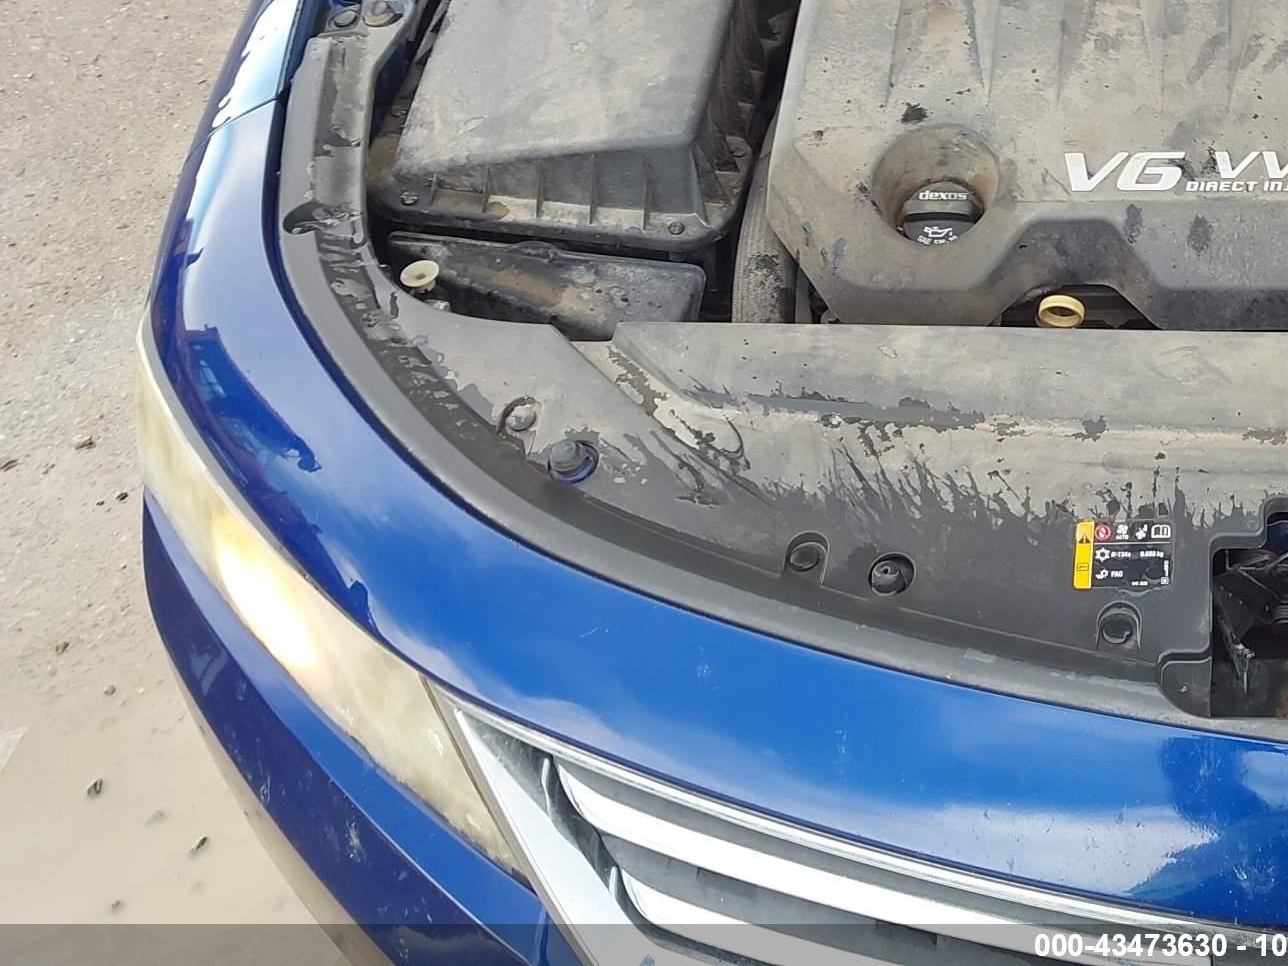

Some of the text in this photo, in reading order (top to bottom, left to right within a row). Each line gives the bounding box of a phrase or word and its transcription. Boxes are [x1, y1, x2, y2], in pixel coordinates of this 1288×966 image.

[1064, 151, 1186, 192] V6
[1185, 181, 1260, 192] DIRECT
[919, 190, 968, 200] dexos
